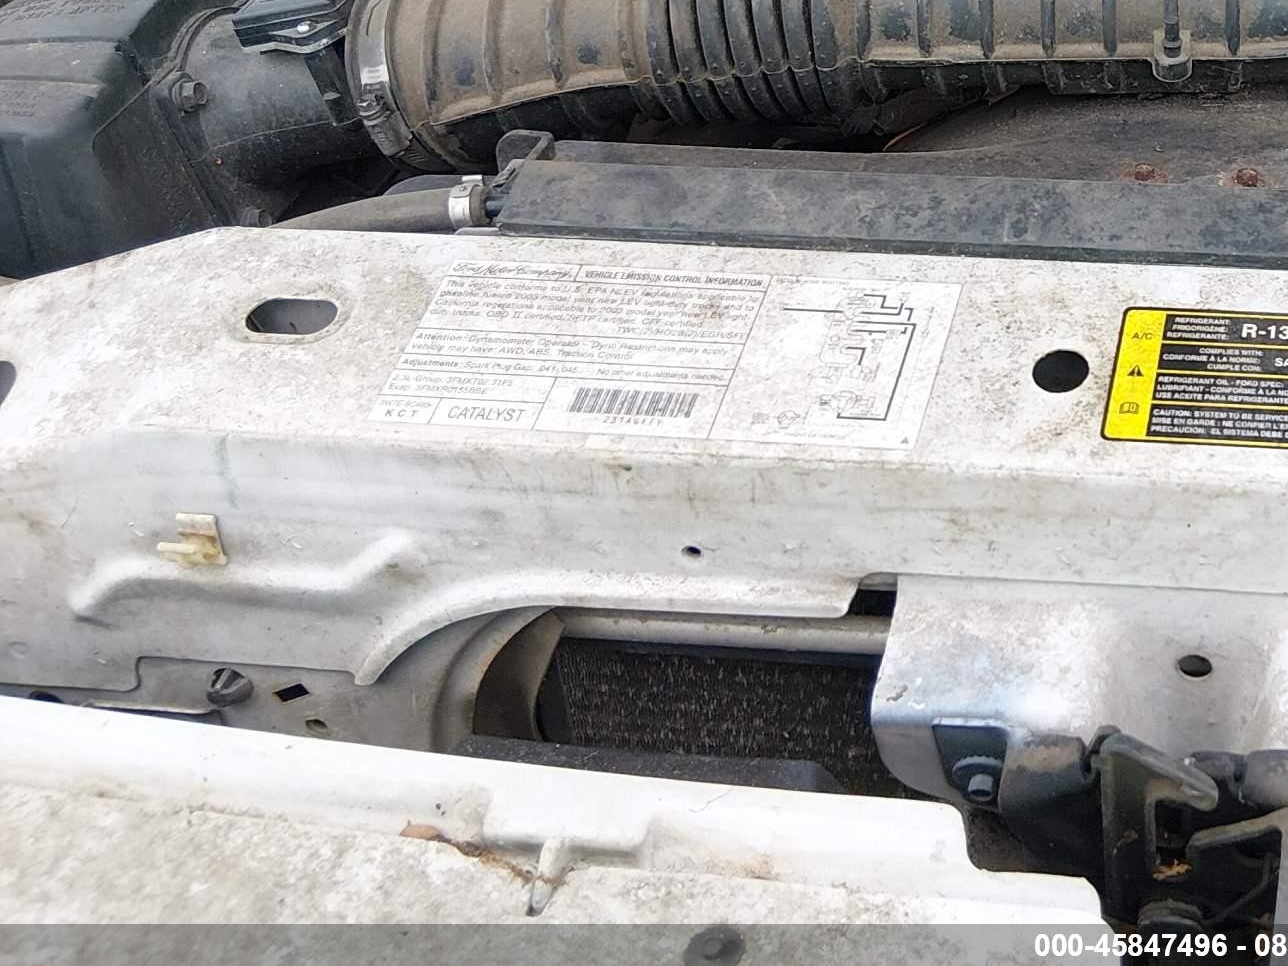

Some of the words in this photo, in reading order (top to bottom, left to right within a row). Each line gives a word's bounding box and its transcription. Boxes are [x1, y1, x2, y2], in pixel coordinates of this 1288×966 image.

[619, 272, 662, 281] EMISSION
[662, 274, 702, 283] CONTROL
[703, 276, 763, 287] INFORMATION
[1131, 332, 1153, 340] A/C
[1198, 347, 1240, 355] COMPLIES
[1162, 352, 1209, 362] CONFORME
[1216, 355, 1228, 363] LA
[1206, 363, 1241, 371] CUMPLE
[1157, 375, 1214, 385] REFRIGERANT
[1210, 386, 1256, 395] CONFORME
[1173, 391, 1203, 400] ACEITE
[1203, 393, 1226, 401] PARA
[445, 404, 528, 422] CATALYST
[1152, 408, 1192, 417] CAUTION:
[1193, 410, 1227, 419] SYSTEM
[1228, 412, 1240, 420] TO
[1151, 416, 1171, 424] MISE
[1186, 418, 1215, 426] GARDE
[1235, 421, 1271, 429] CONFIER
[1210, 427, 1221, 435] EL
[1223, 428, 1259, 437] SISTEMA
[1260, 430, 1283, 439] DEBE
